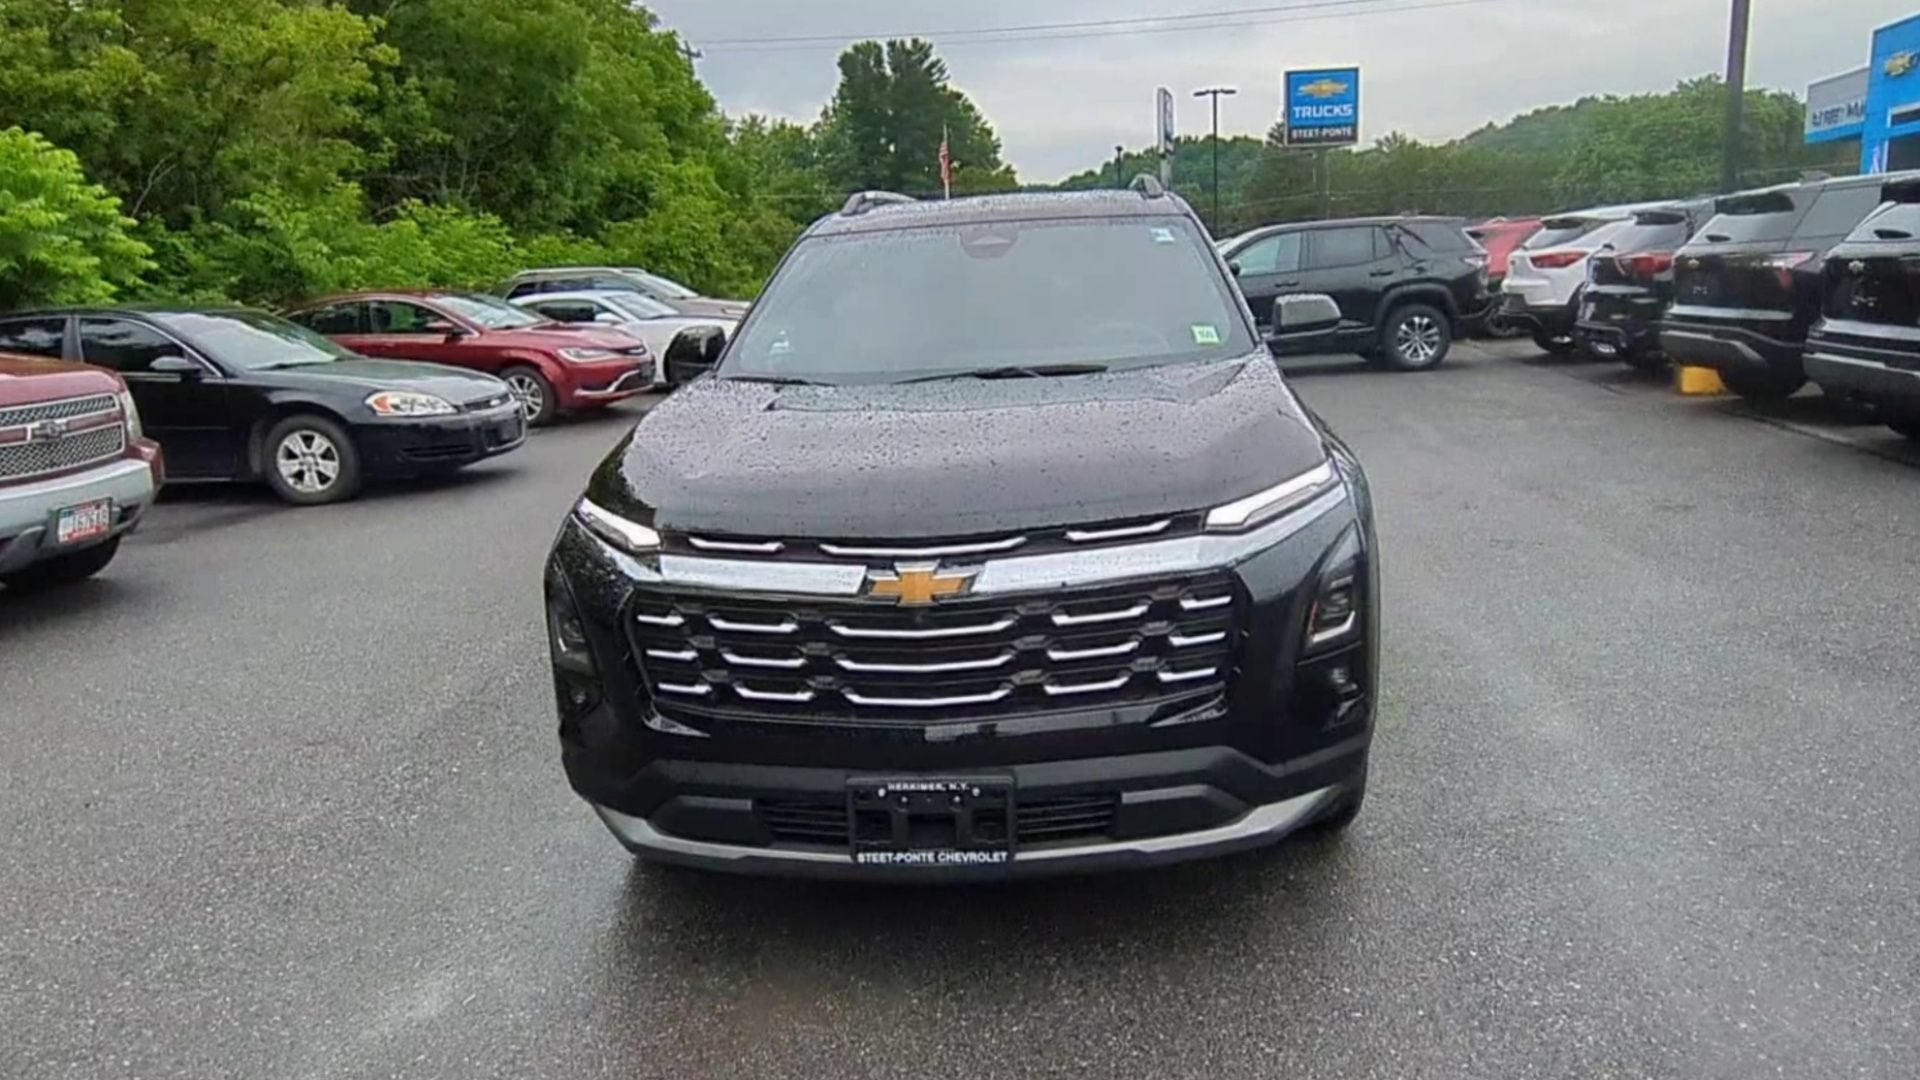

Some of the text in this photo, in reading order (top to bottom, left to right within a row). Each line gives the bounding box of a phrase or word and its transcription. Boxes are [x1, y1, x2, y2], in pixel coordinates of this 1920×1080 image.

[1293, 103, 1353, 118] TRUCKS
[949, 782, 971, 791] N.Y.
[856, 851, 1009, 864] STEET-PONTE CHEVROLET
